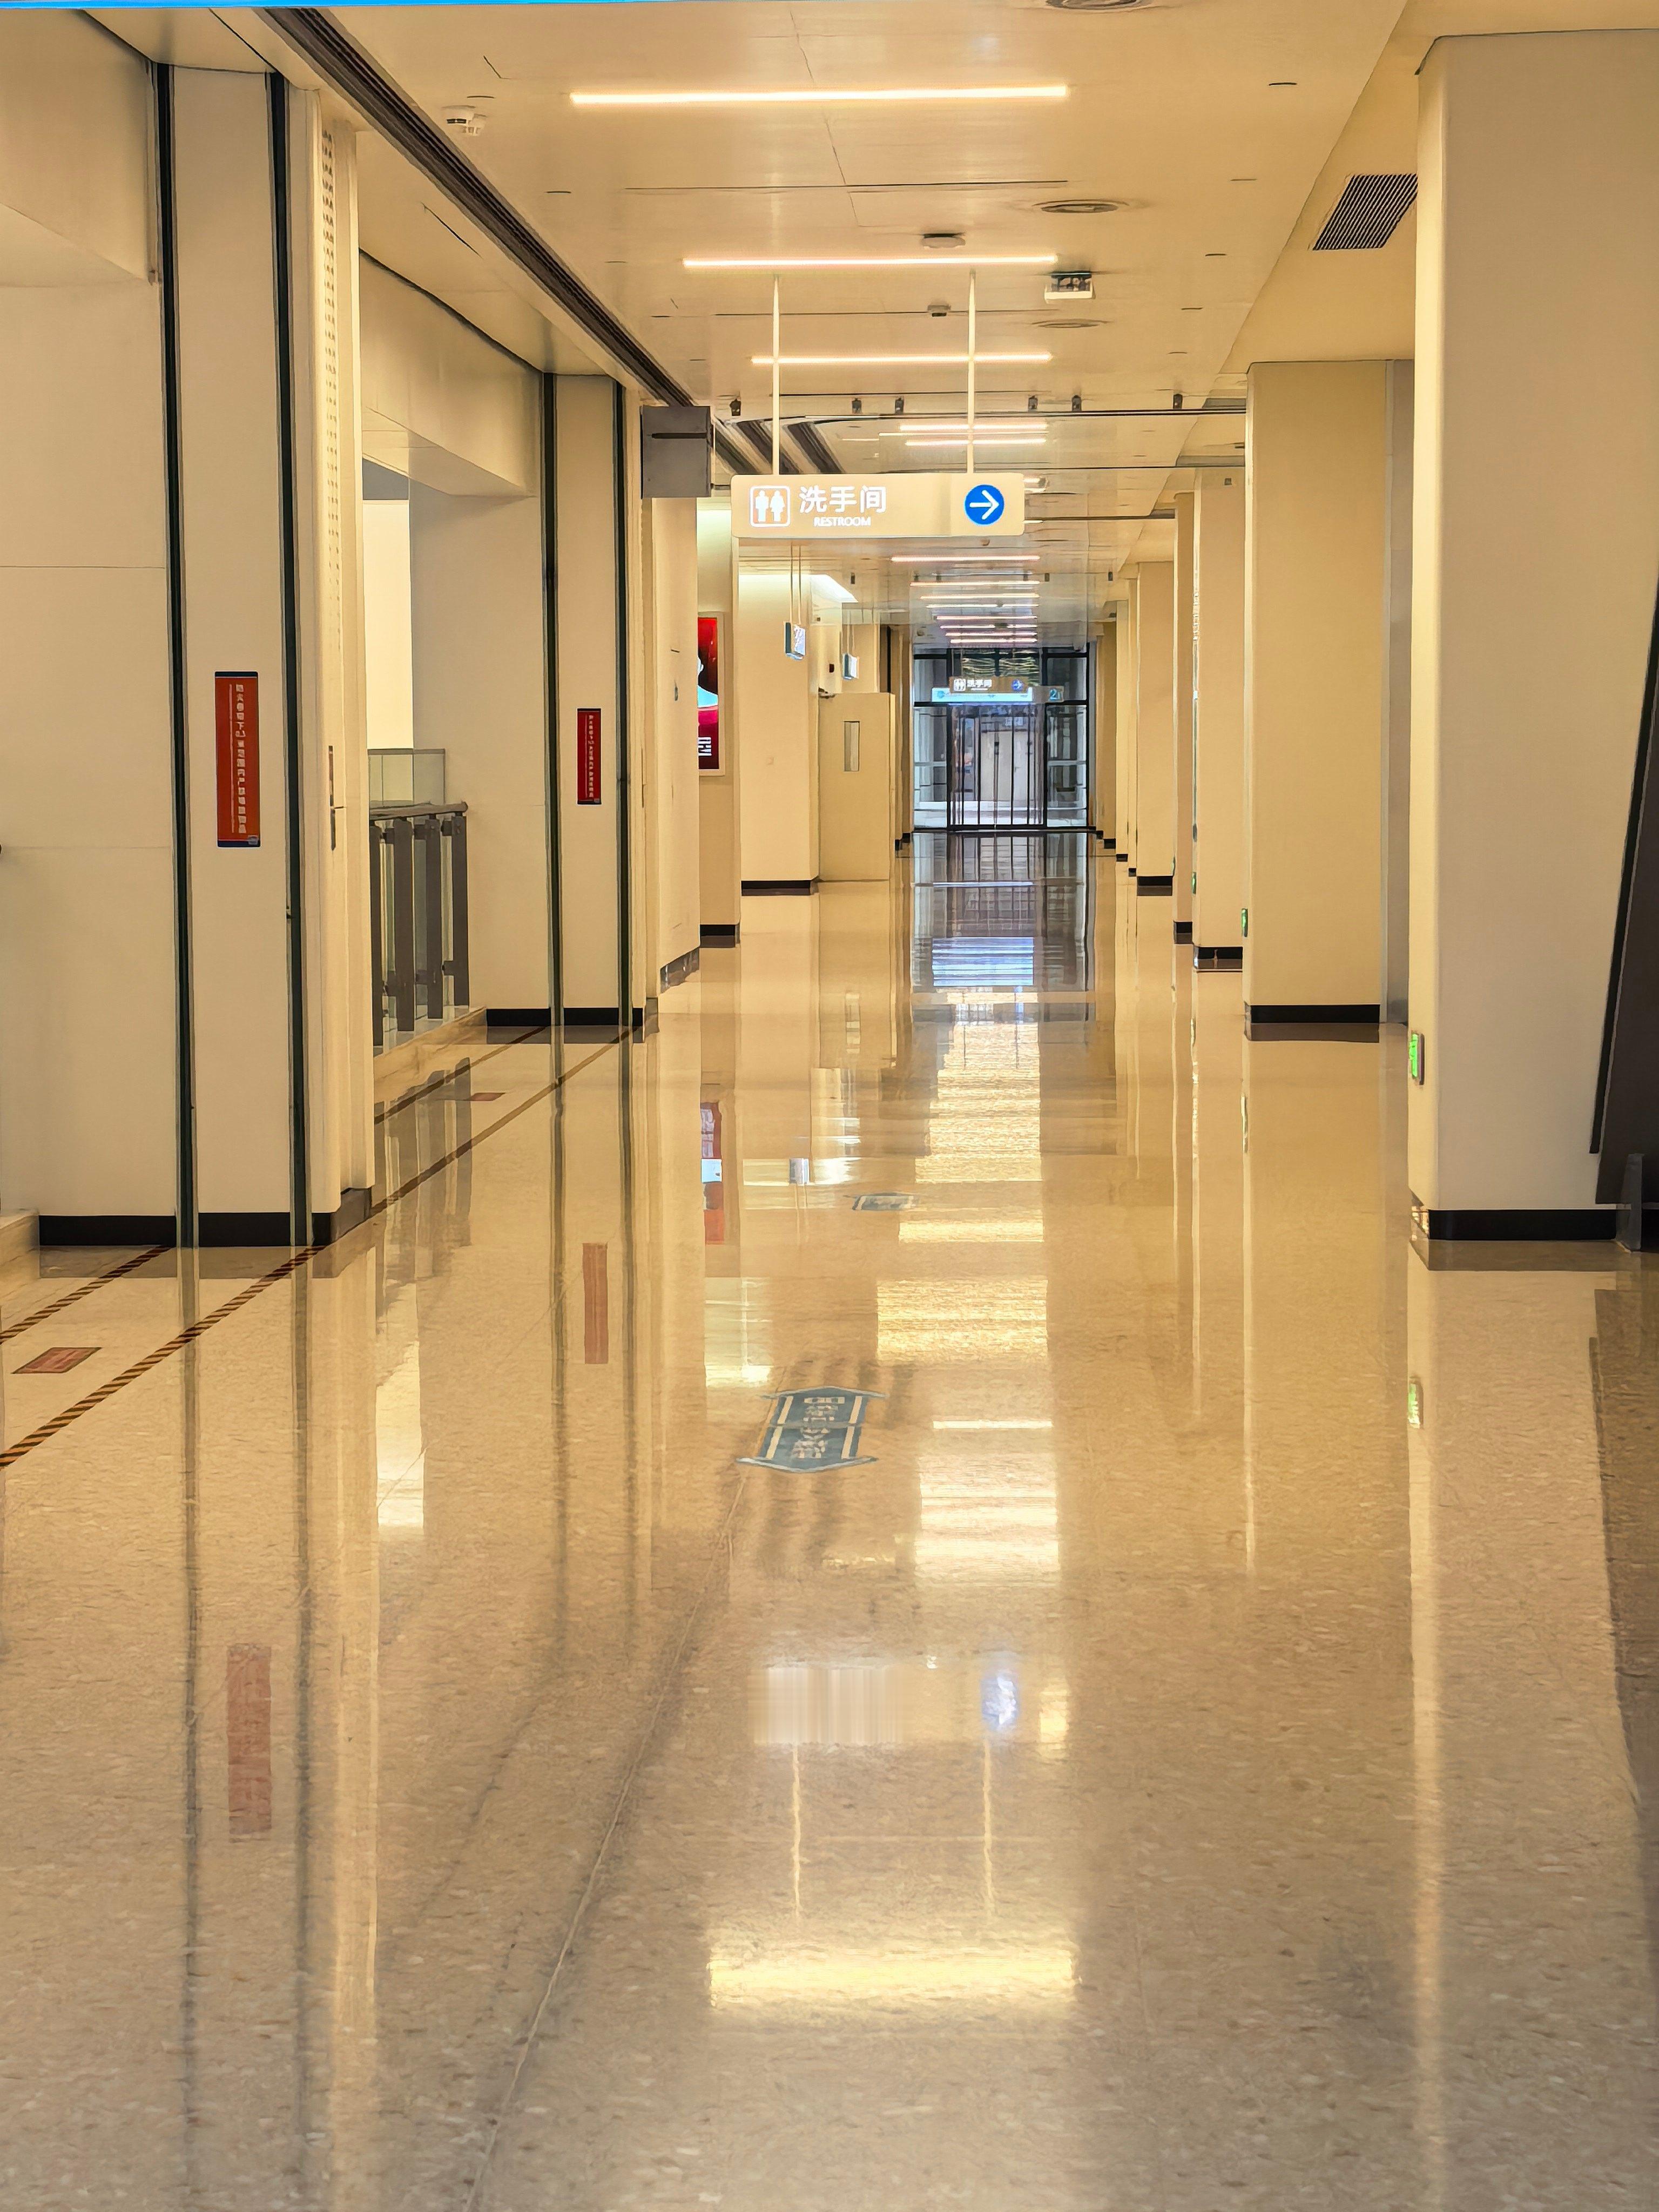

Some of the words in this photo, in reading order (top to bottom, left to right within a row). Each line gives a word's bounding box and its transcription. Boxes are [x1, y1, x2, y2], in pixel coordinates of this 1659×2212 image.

[799, 484, 887, 513] 洗手间
[814, 516, 872, 527] RESTROOM
